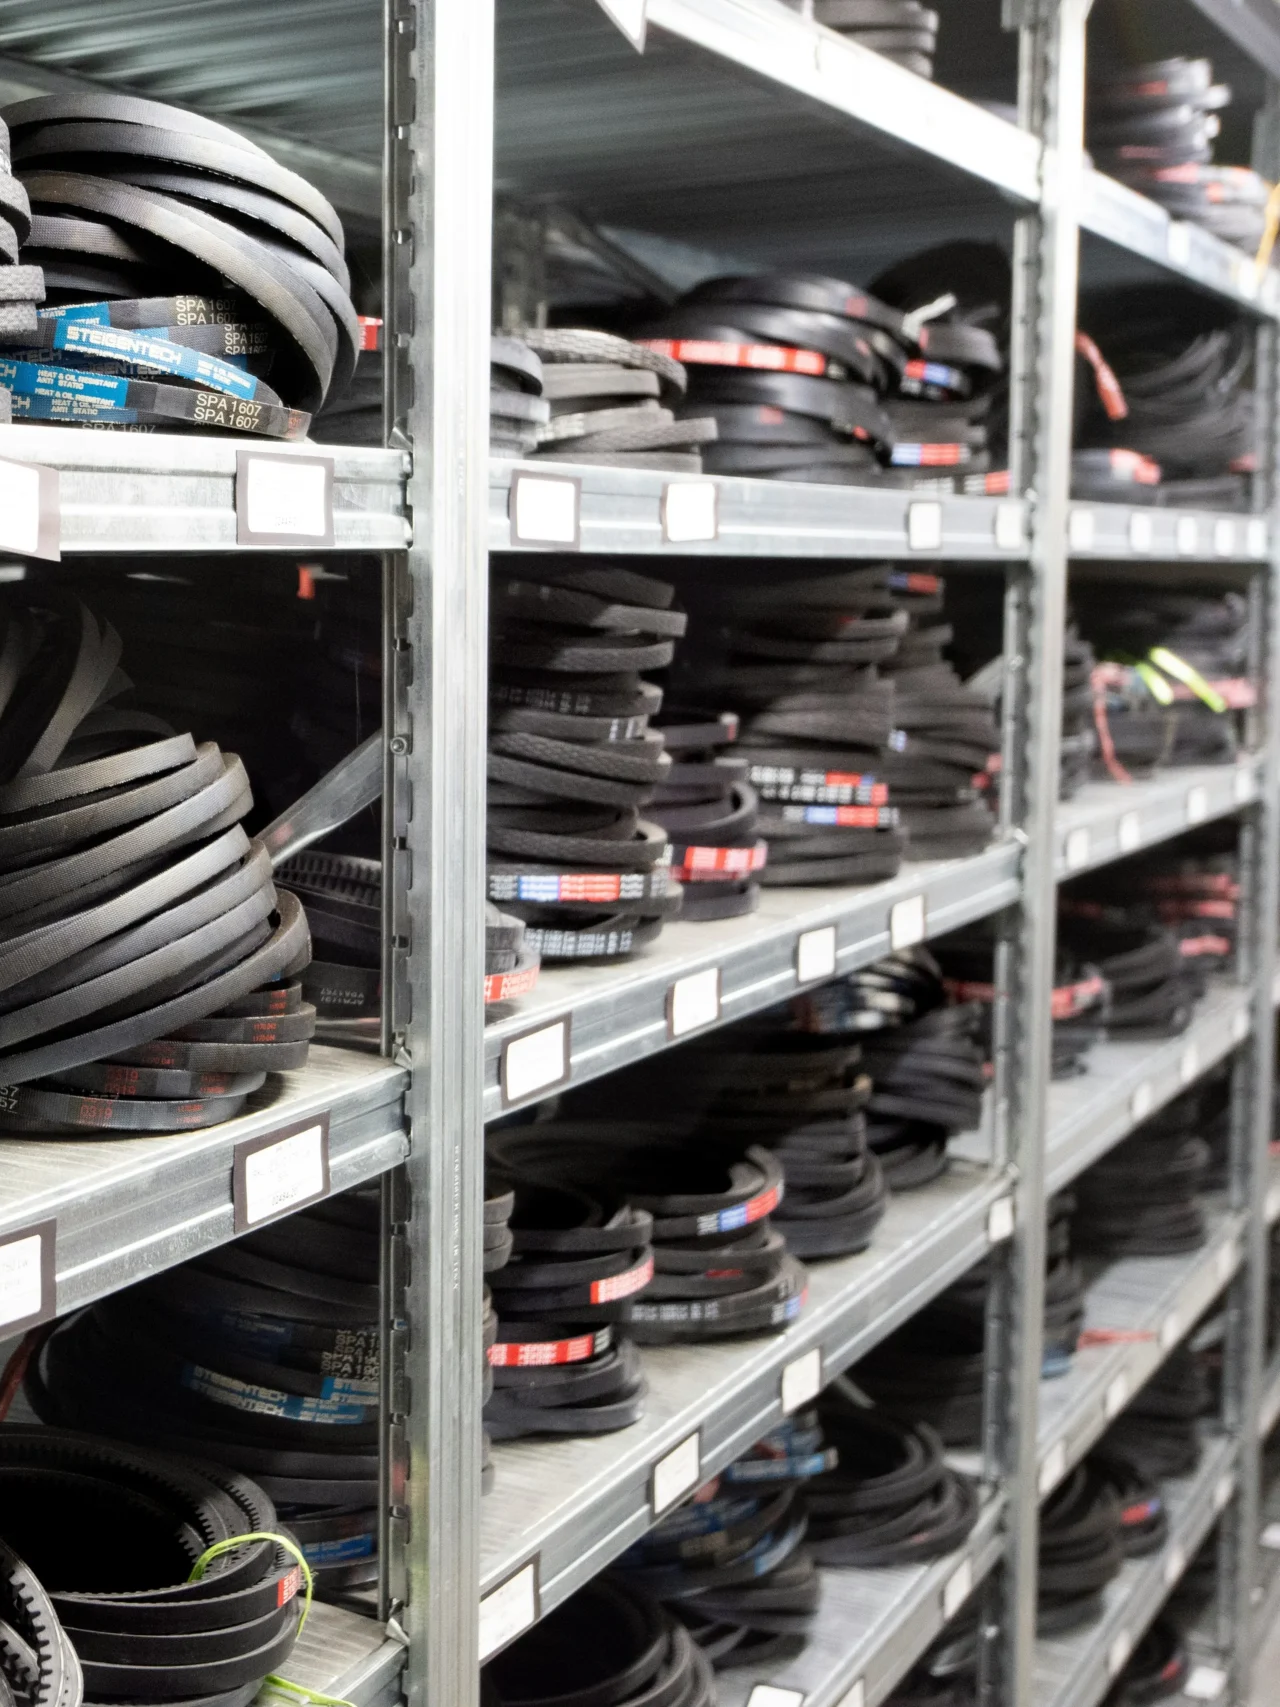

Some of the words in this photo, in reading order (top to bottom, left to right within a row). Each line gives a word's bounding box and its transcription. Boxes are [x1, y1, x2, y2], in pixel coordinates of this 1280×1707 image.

[176, 299, 206, 312] SPA
[177, 312, 207, 326] SPA
[66, 324, 182, 365] STEIGENTECH
[225, 332, 247, 345] SPA
[58, 380, 84, 390] STATIC
[73, 406, 98, 415] STATIC
[196, 393, 228, 410] SPA
[231, 400, 262, 417] 1607
[193, 406, 225, 423] SPA
[229, 413, 260, 430] 1607
